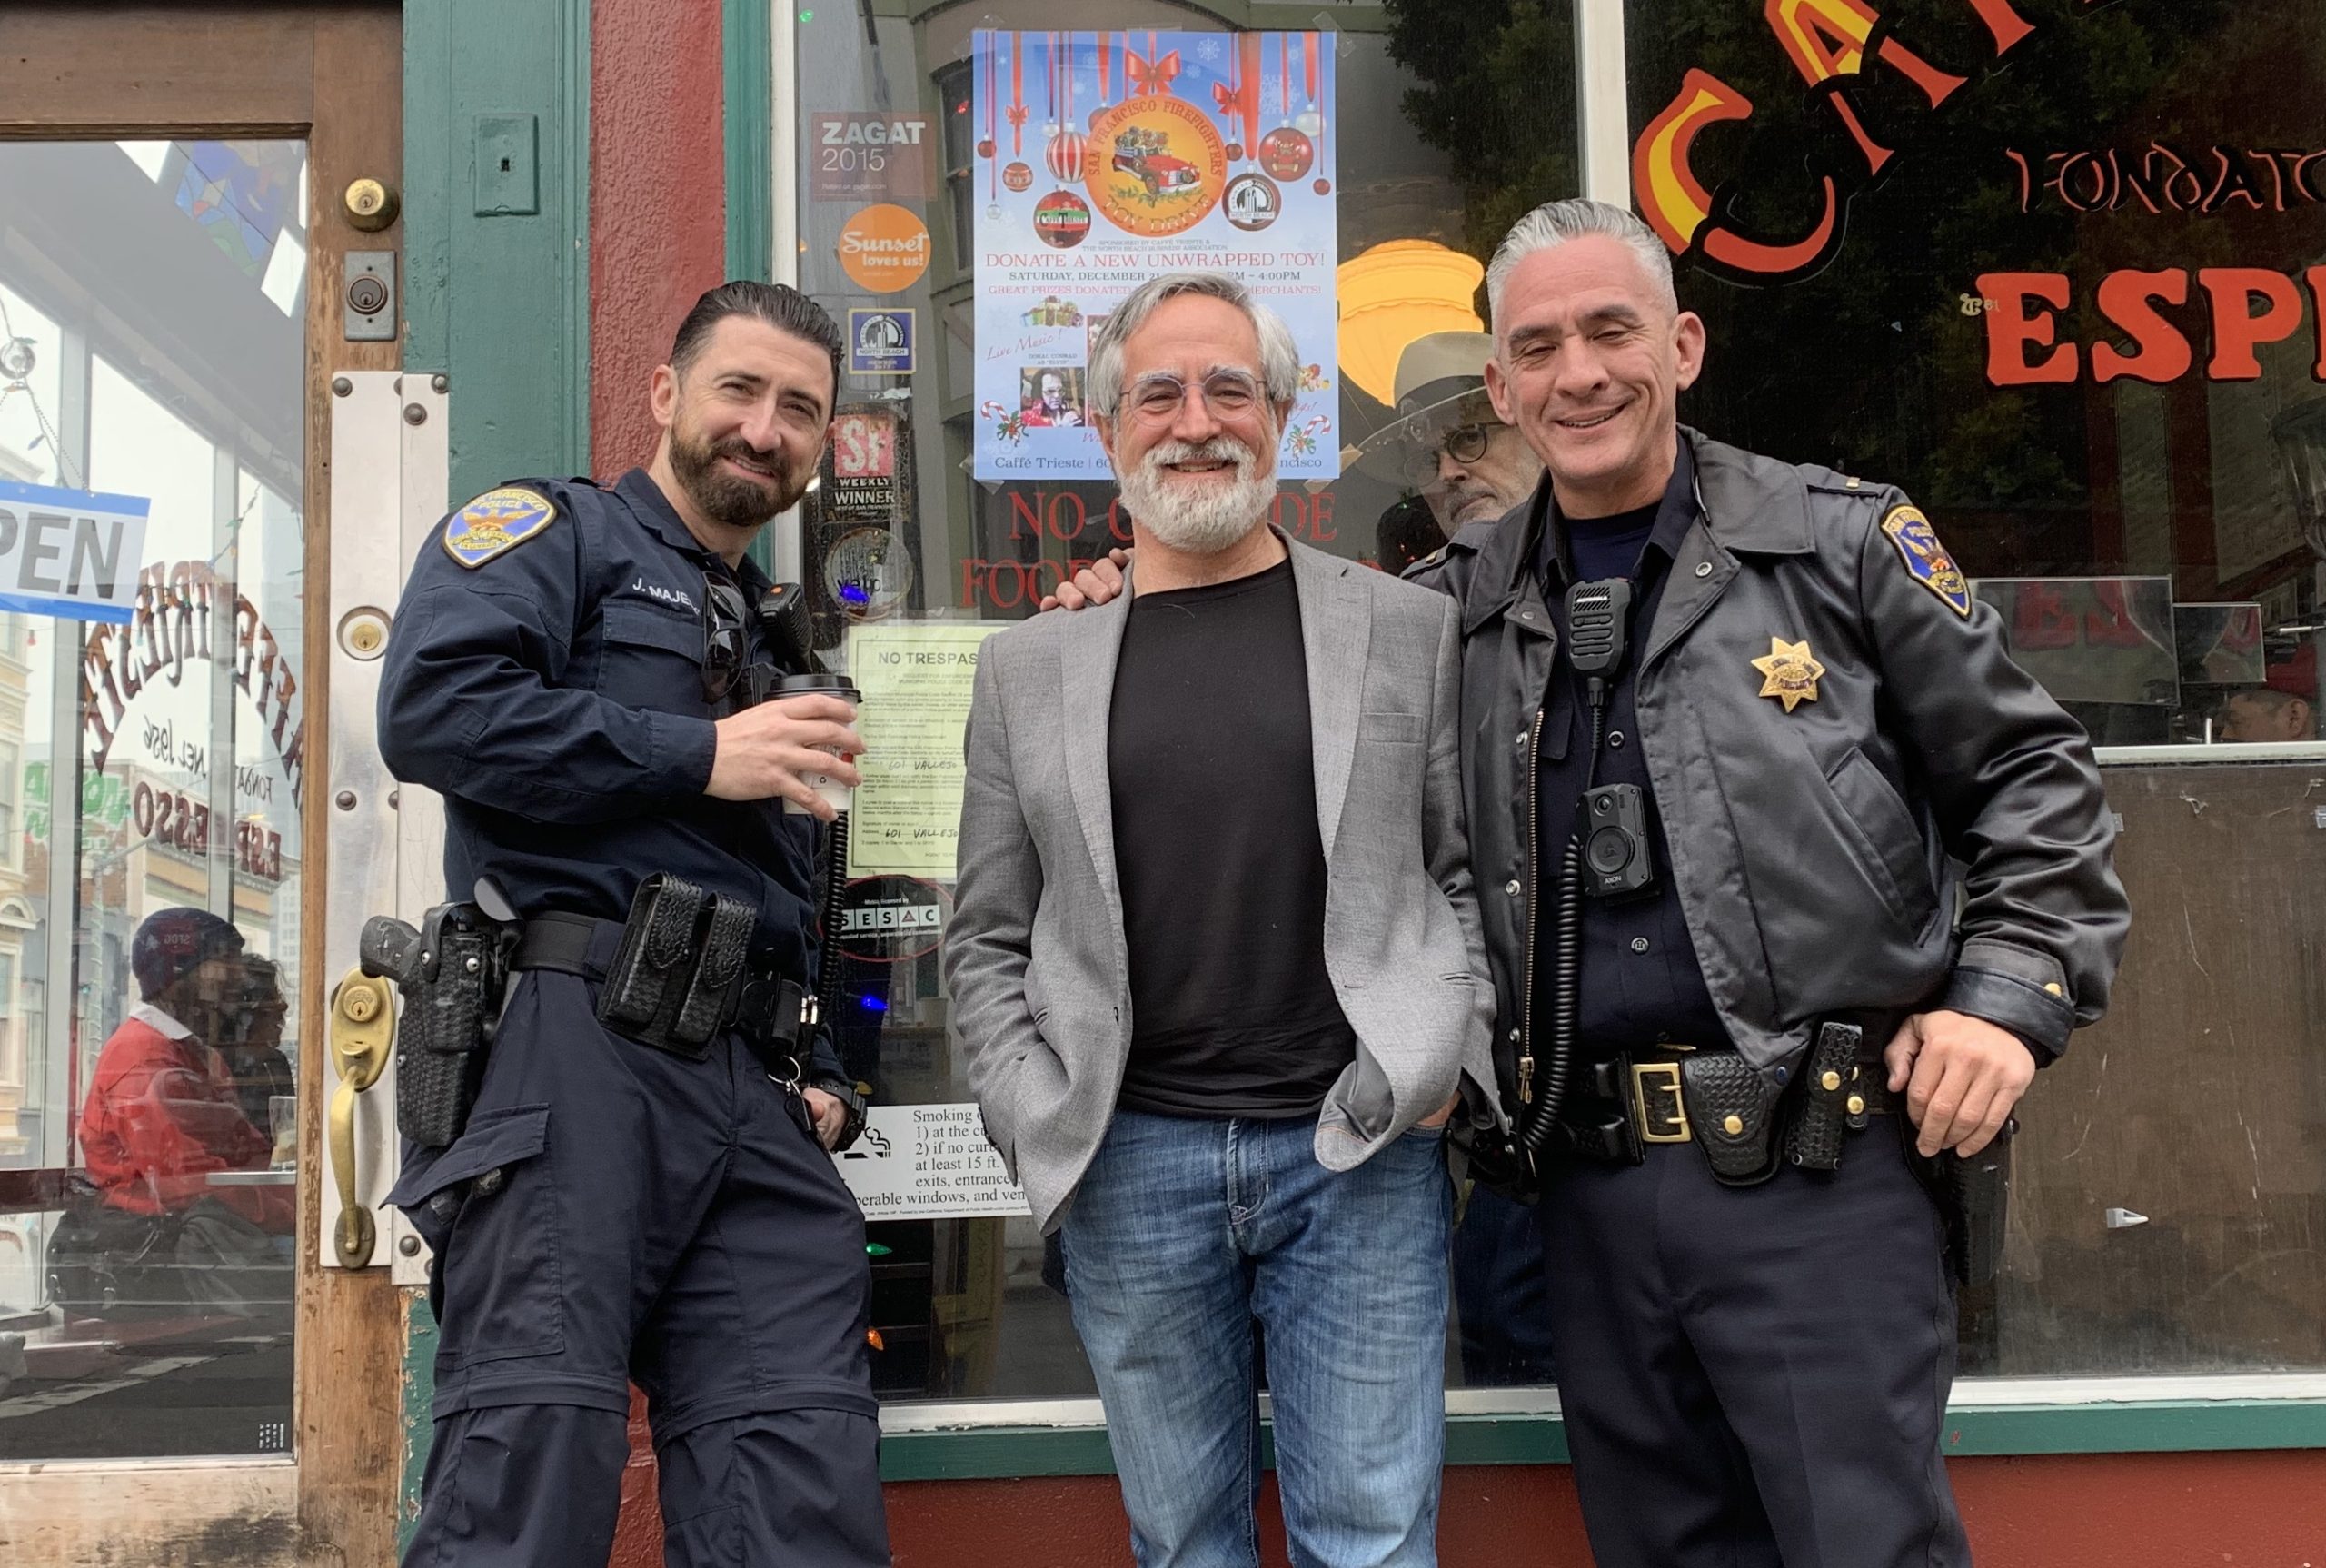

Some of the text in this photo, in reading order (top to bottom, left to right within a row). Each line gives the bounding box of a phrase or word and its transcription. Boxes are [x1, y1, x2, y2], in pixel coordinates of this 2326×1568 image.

[821, 121, 927, 145] ZAGAT
[1088, 100, 1223, 176] SAN FRANCISCO FIREFIGHTERS
[1634, 0, 2037, 276] CA
[821, 147, 886, 172] 2015
[1102, 193, 1217, 233] TOY DRIVE
[841, 230, 930, 254] Sunset
[862, 253, 924, 267] loves us!
[986, 253, 1326, 268] DONATE A NEW UNWRAPPED TOY!
[1009, 271, 1075, 283] SATURDAY,
[1078, 272, 1145, 281] DECEMBER
[1257, 271, 1301, 280] 4:00PM
[988, 285, 1028, 294] GREAT
[1031, 285, 1072, 294] PRIZES
[1074, 285, 1130, 294] DONATED
[1975, 267, 2326, 386] ESP
[987, 345, 1013, 362] Live
[994, 455, 1322, 469] Caffé Trieste 60 ncisco
[839, 478, 890, 487] WEEKLY
[834, 491, 895, 505] WINNER
[1009, 491, 1087, 541] NO
[960, 557, 1095, 609] FOO
[632, 577, 701, 616] J. MAJE
[878, 651, 978, 665] NO TRESPAS
[888, 759, 957, 771] 601 VALLEJO
[885, 828, 958, 839] 601 VALLEJO
[913, 1108, 973, 1124] Smoking
[917, 1125, 985, 1141] 1) at the cu
[916, 1142, 929, 1156] 2)
[934, 1141, 946, 1155] if
[948, 1145, 963, 1154] no
[915, 1156, 1000, 1171] at least 15 ft.
[916, 1174, 1021, 1187] exits, entrance,
[855, 1186, 1026, 1206] perable windows, and ven
